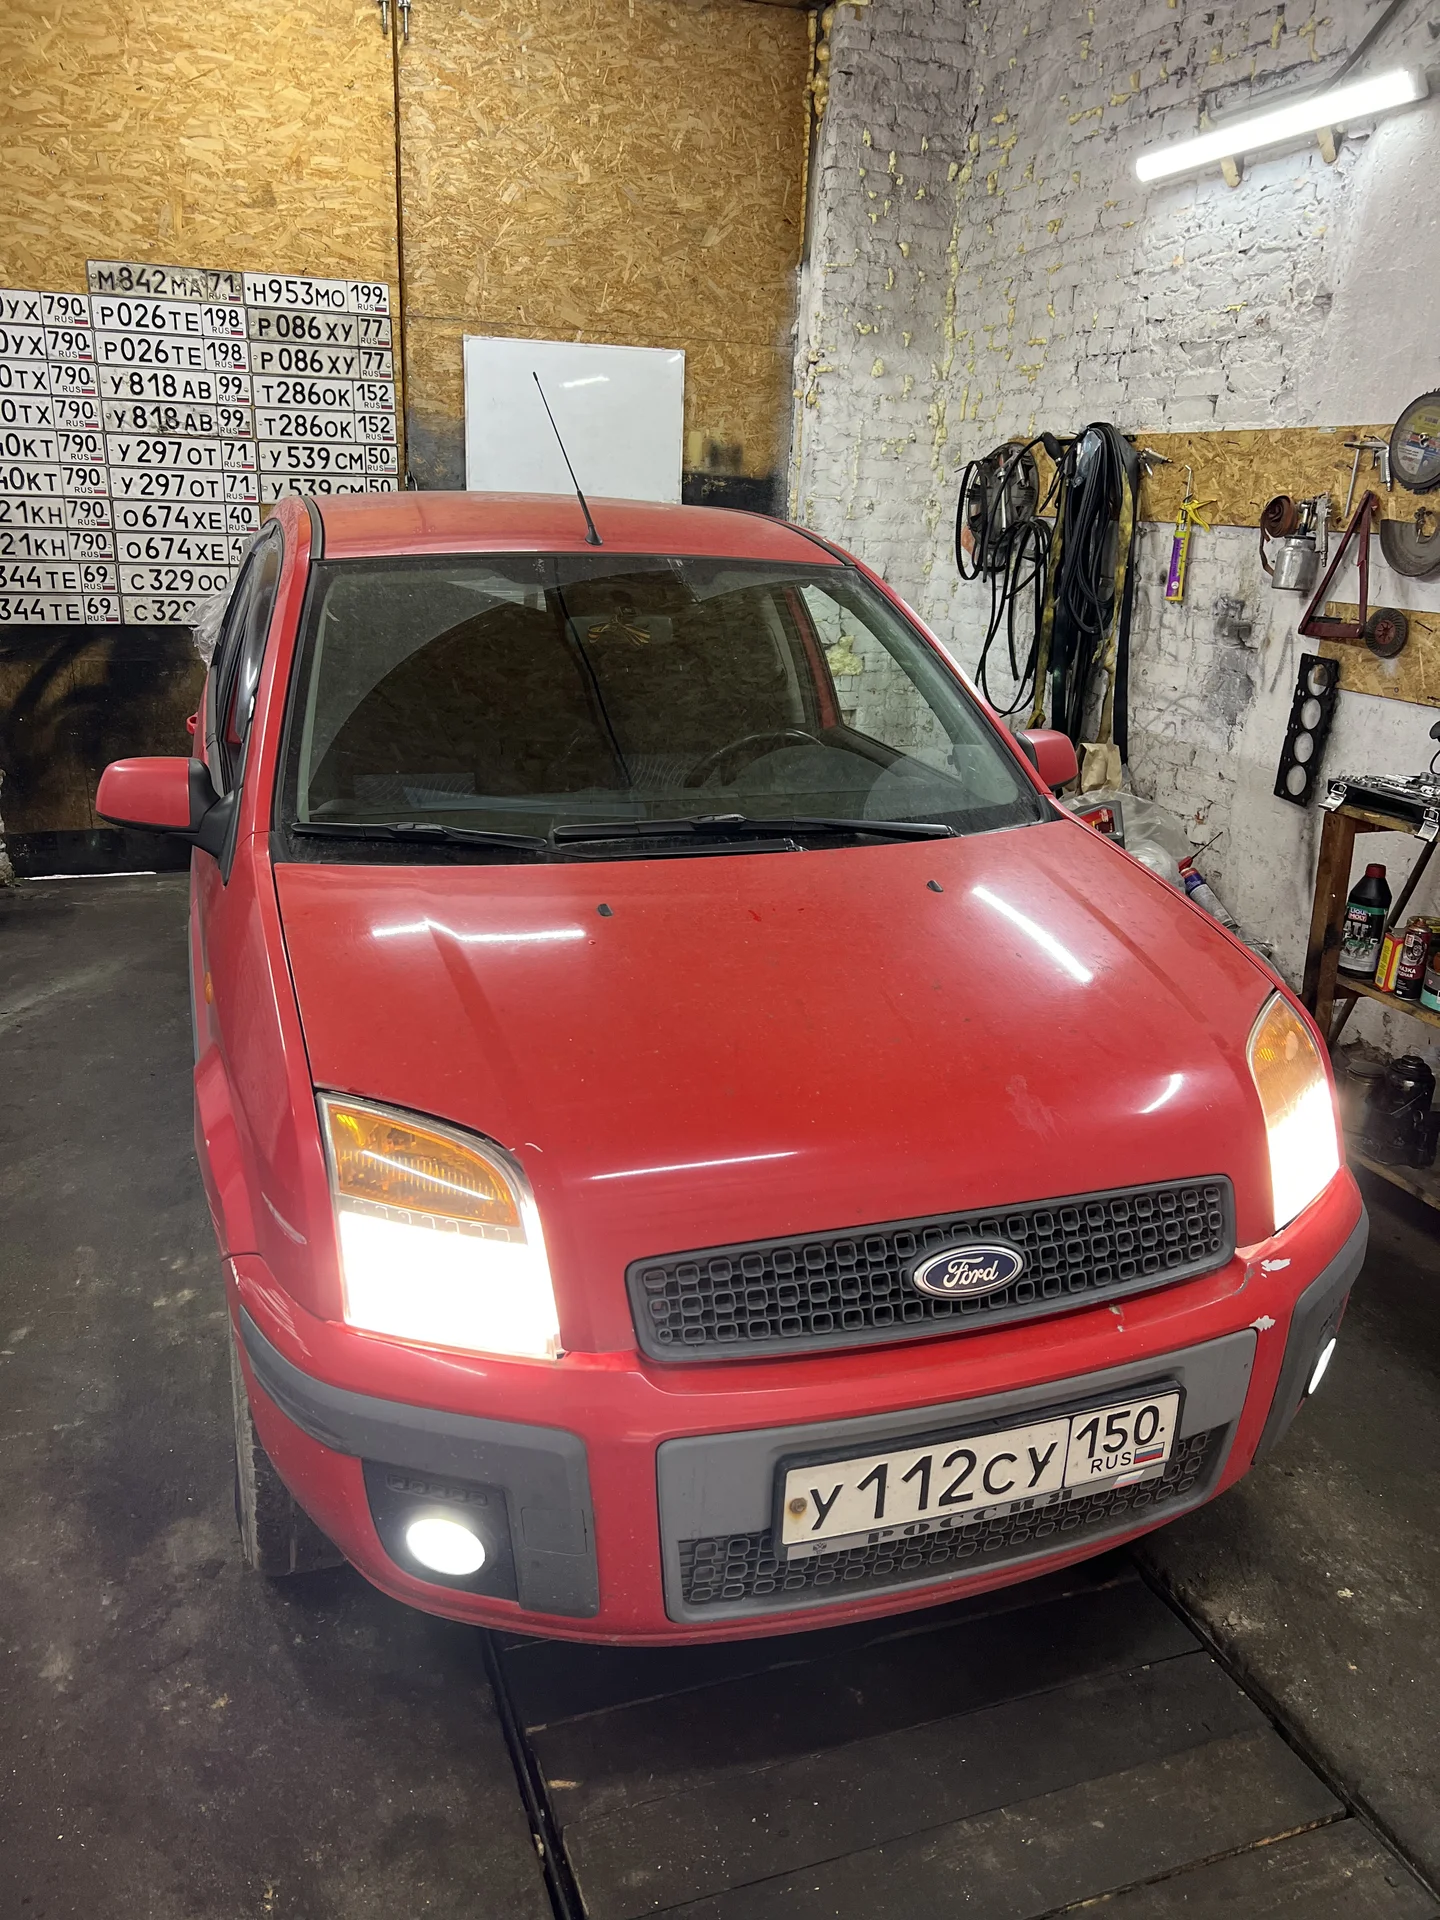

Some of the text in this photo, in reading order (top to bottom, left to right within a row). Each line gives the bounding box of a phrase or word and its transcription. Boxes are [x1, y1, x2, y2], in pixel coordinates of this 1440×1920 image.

[209, 273, 234, 293] 71
[253, 279, 383, 307] Н953МО 199
[0, 295, 83, 321] УХ 790
[54, 315, 73, 323] RUS
[100, 302, 240, 331] Р026ТЕ 198
[357, 303, 374, 311] RUS
[258, 314, 383, 342] Р086ХУ 77
[47, 330, 87, 351] 790
[104, 337, 242, 366] Р026ТЕ 198
[58, 350, 77, 358] RUS
[215, 361, 233, 369] RUS
[261, 348, 384, 375] Р086ХУ 77
[51, 365, 90, 385] 790
[110, 372, 242, 399] У818АВ 99
[62, 385, 81, 393] RUS
[219, 394, 236, 402] RUS
[262, 381, 389, 407] Т286ОК 152
[55, 400, 94, 419] 790
[114, 406, 244, 431] У818АВ 99
[264, 413, 390, 438] Т286ОК 152
[0, 433, 97, 458] 0КТ 790
[118, 439, 248, 466] У297ОТ 71
[270, 446, 390, 470] У539СМ 50
[63, 467, 100, 486] 790
[121, 473, 249, 498] У297ОТ 71
[67, 500, 104, 518] 790
[123, 505, 252, 529] О674ХЕ 40
[0, 533, 107, 556] 21КН 790
[126, 537, 224, 561] О674ХЕ
[84, 566, 108, 583] 69
[87, 598, 111, 615] 69
[943, 1257, 998, 1287] Ford
[810, 1405, 1159, 1531] У112СУ 150
[1090, 1451, 1132, 1474] RUS
